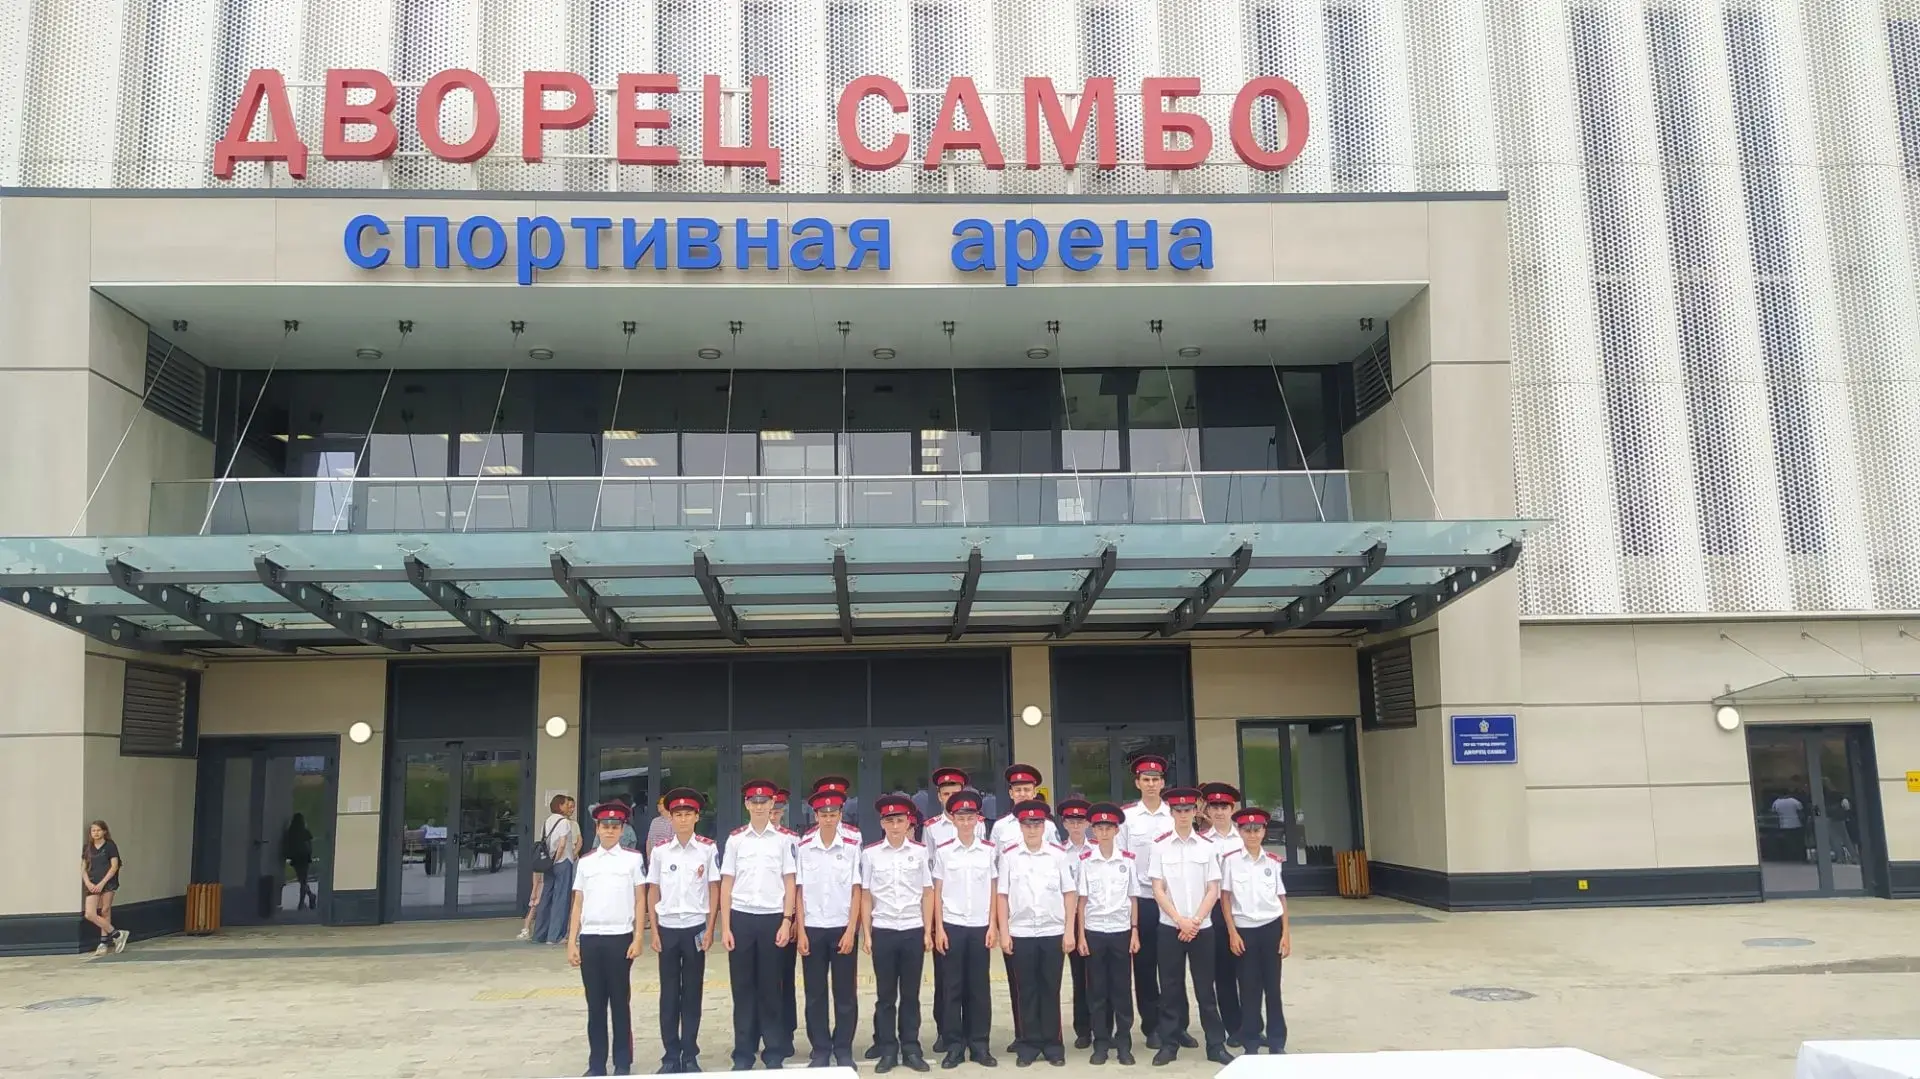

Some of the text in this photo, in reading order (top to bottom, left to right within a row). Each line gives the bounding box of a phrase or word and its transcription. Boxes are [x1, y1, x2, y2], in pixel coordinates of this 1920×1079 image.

[214, 68, 1311, 184] ДВОРЕЦ САМБО
[343, 214, 1215, 287] спортивная арена
